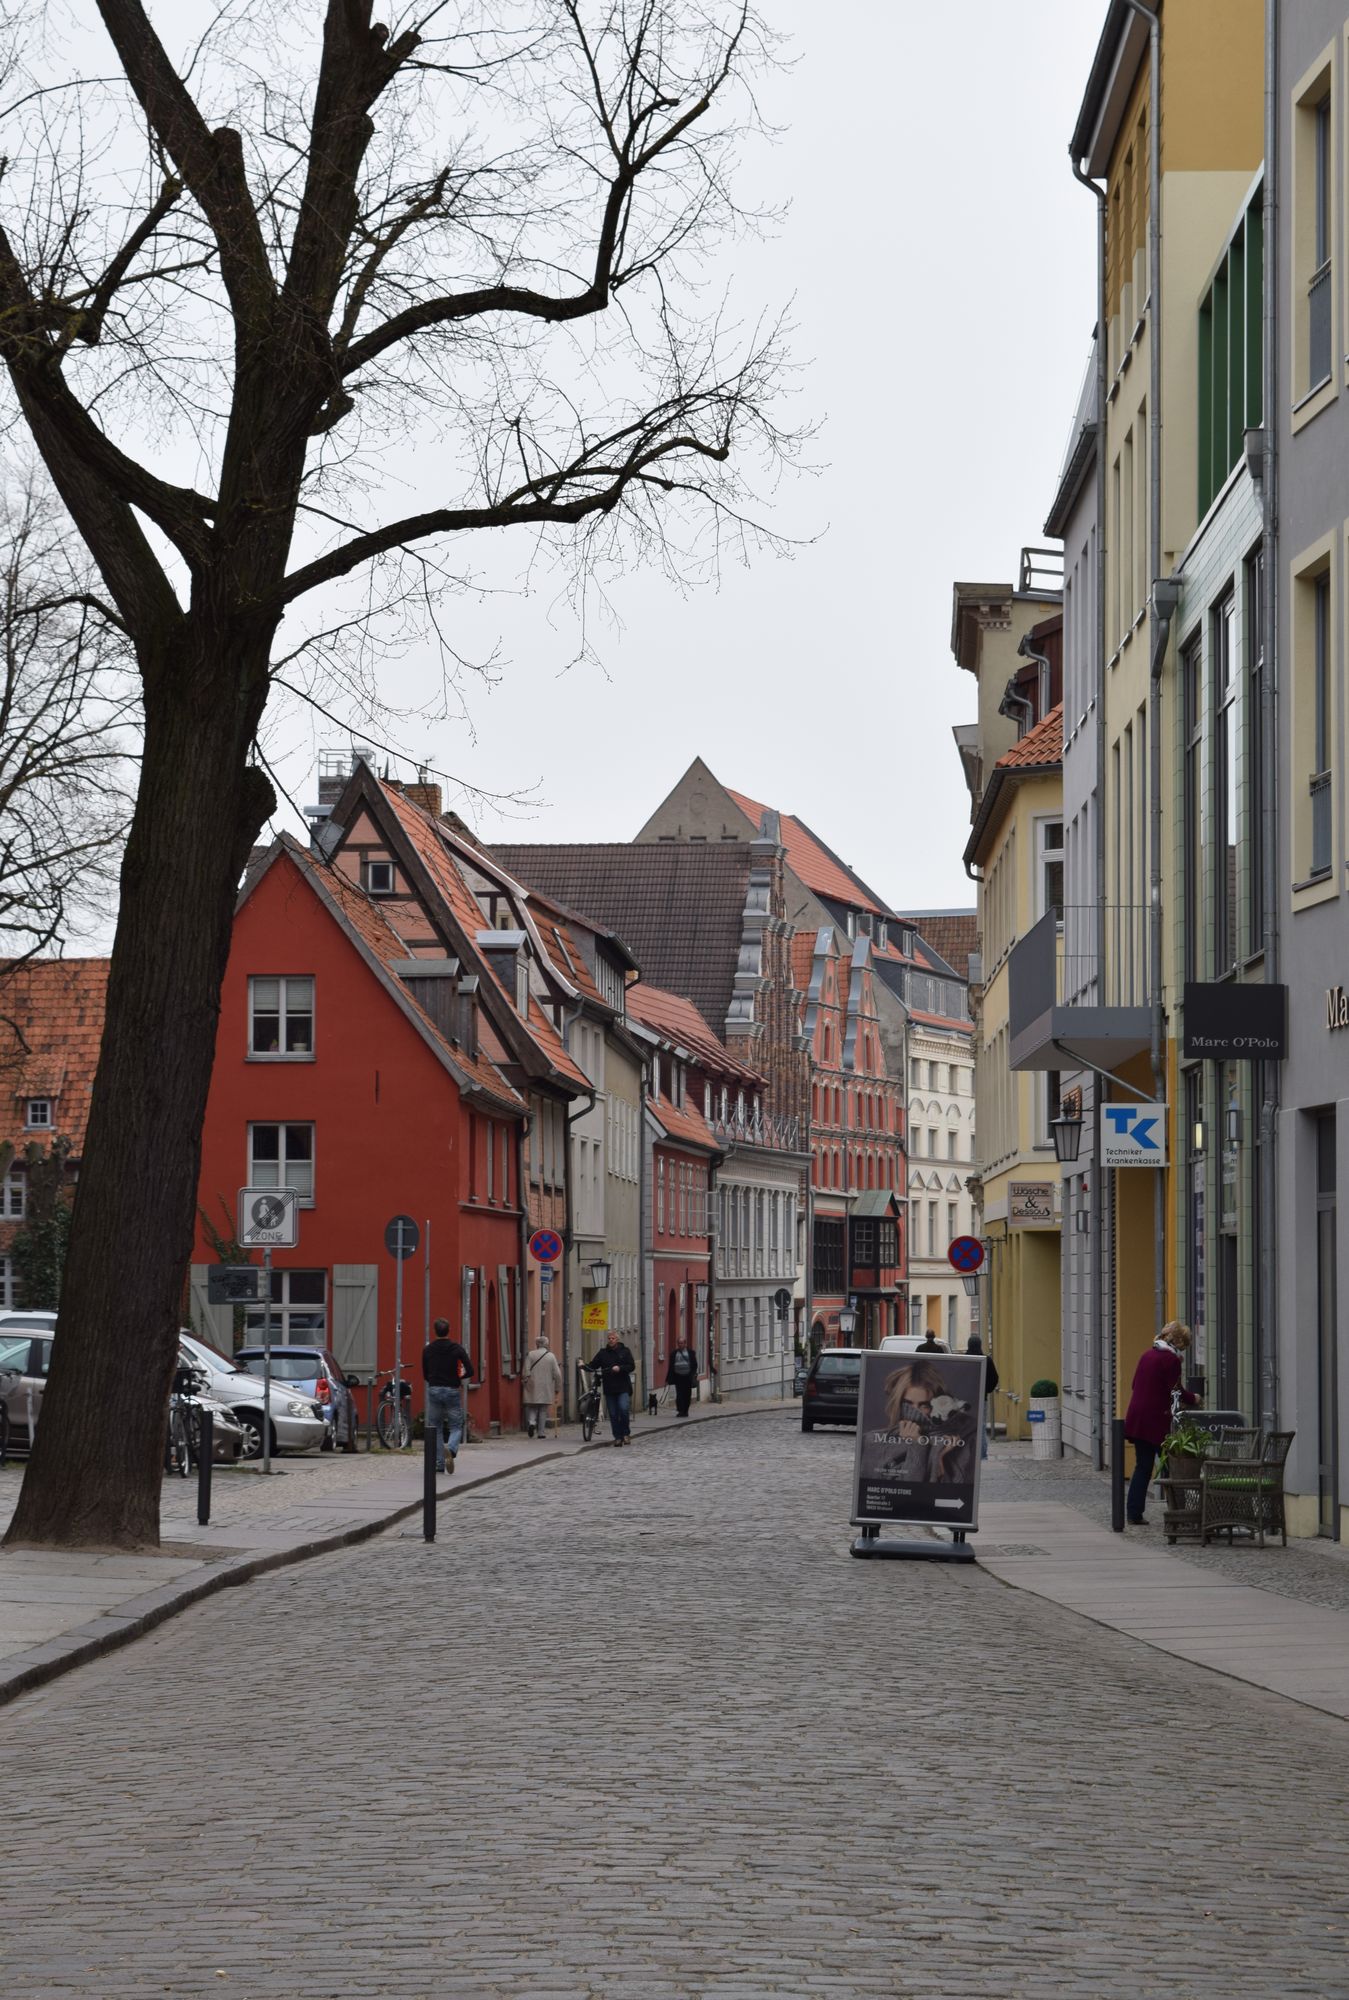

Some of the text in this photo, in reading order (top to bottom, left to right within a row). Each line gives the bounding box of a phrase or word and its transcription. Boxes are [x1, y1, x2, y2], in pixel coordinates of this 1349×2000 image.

[1191, 1036, 1279, 1048] Marc O'Polo
[1105, 1107, 1160, 1150] TK
[1105, 1148, 1143, 1156] Techniker
[1106, 1157, 1161, 1165] Krankenkasse
[1025, 1195, 1040, 1209] &
[255, 1231, 283, 1241] ZONE
[873, 1432, 966, 1448] Marc O'Polo
